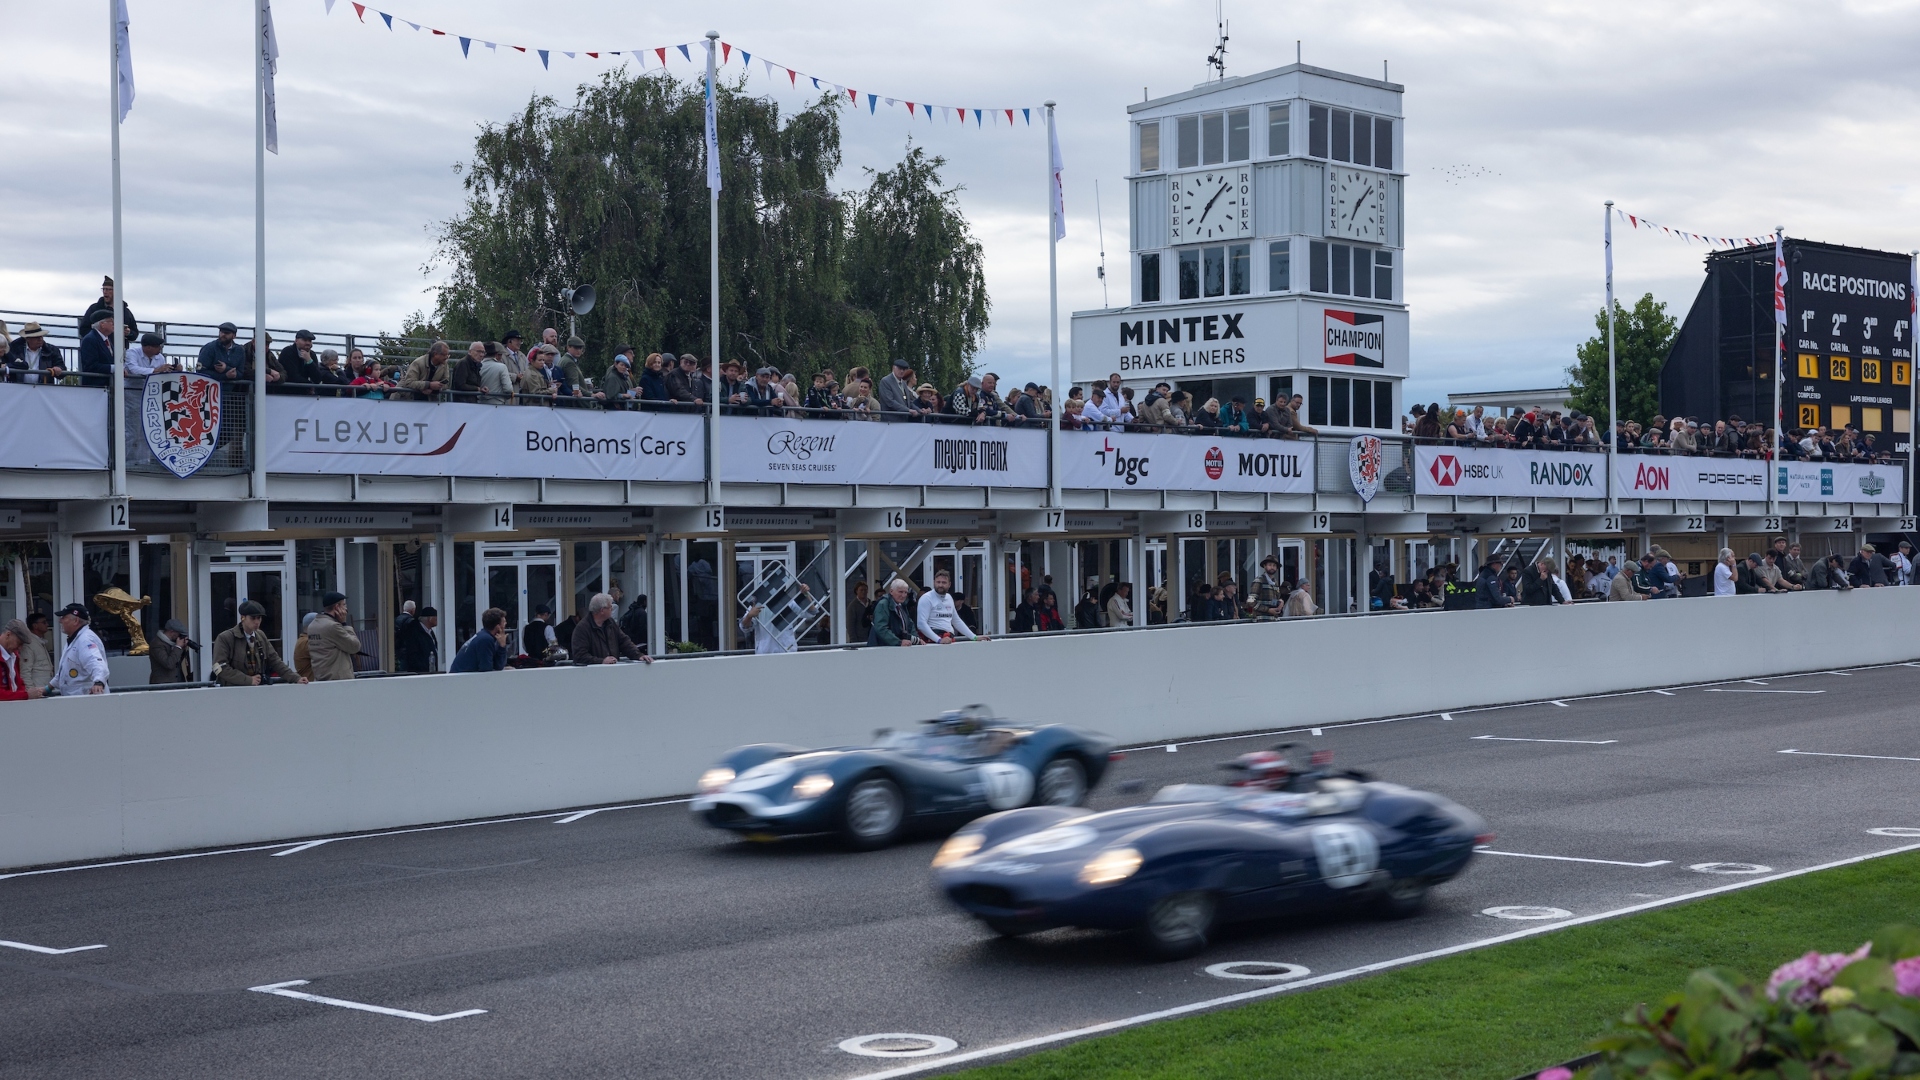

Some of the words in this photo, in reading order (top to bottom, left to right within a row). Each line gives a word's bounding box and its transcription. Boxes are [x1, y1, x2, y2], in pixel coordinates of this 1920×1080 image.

[1171, 181, 1180, 238] ROLEX
[1240, 173, 1249, 230] ROLEX
[1802, 271, 1837, 293] RACE
[1839, 275, 1906, 301] POSITIONS
[1120, 313, 1244, 347] MINTEX
[1327, 328, 1382, 350] CHAMPION
[1799, 339, 1809, 349] CAR
[1830, 342, 1841, 352] CAR
[1862, 345, 1872, 355] CAR
[1892, 348, 1902, 357] CAR
[1120, 352, 1176, 371] BRAKE
[1183, 347, 1245, 367] LINERS
[1806, 358, 1811, 375] 1
[1832, 360, 1847, 377] 26
[1863, 362, 1877, 380] 88
[1897, 365, 1904, 382] 5
[1862, 396, 1876, 404] BEHIND
[147, 382, 163, 444] BARC
[1802, 408, 1815, 426] 21
[526, 430, 631, 454] Bonhams
[640, 435, 686, 456] Cars
[767, 430, 836, 460] Regent
[934, 438, 977, 474] meyers
[980, 440, 1008, 471] manx
[1205, 459, 1223, 468] MOTUL
[768, 462, 790, 471] SEVEN
[791, 463, 807, 471] SEAS
[808, 464, 836, 472] CRUISES
[1114, 448, 1149, 485] bgc
[1238, 453, 1302, 478] MOTUL
[1464, 464, 1490, 479] HSBC
[1491, 465, 1504, 480] UK
[1531, 461, 1594, 487] RANDOX
[1634, 462, 1669, 491] AON
[1698, 472, 1763, 486] PORSCHE
[111, 504, 126, 526] 12
[355, 516, 374, 524] TEAM
[495, 507, 510, 527] 14
[529, 516, 554, 524] ECURIE
[557, 516, 592, 524] RICHMOND
[706, 510, 721, 528] 15
[887, 512, 903, 528] 16
[1047, 512, 1061, 527] 17
[1188, 513, 1203, 528] 18
[1313, 515, 1328, 529] 19
[1510, 516, 1526, 529] 20
[1687, 517, 1702, 529] 22
[1605, 517, 1619, 530] 21
[1764, 518, 1780, 530] 23
[1834, 518, 1849, 530] 24
[1900, 519, 1914, 530] 25
